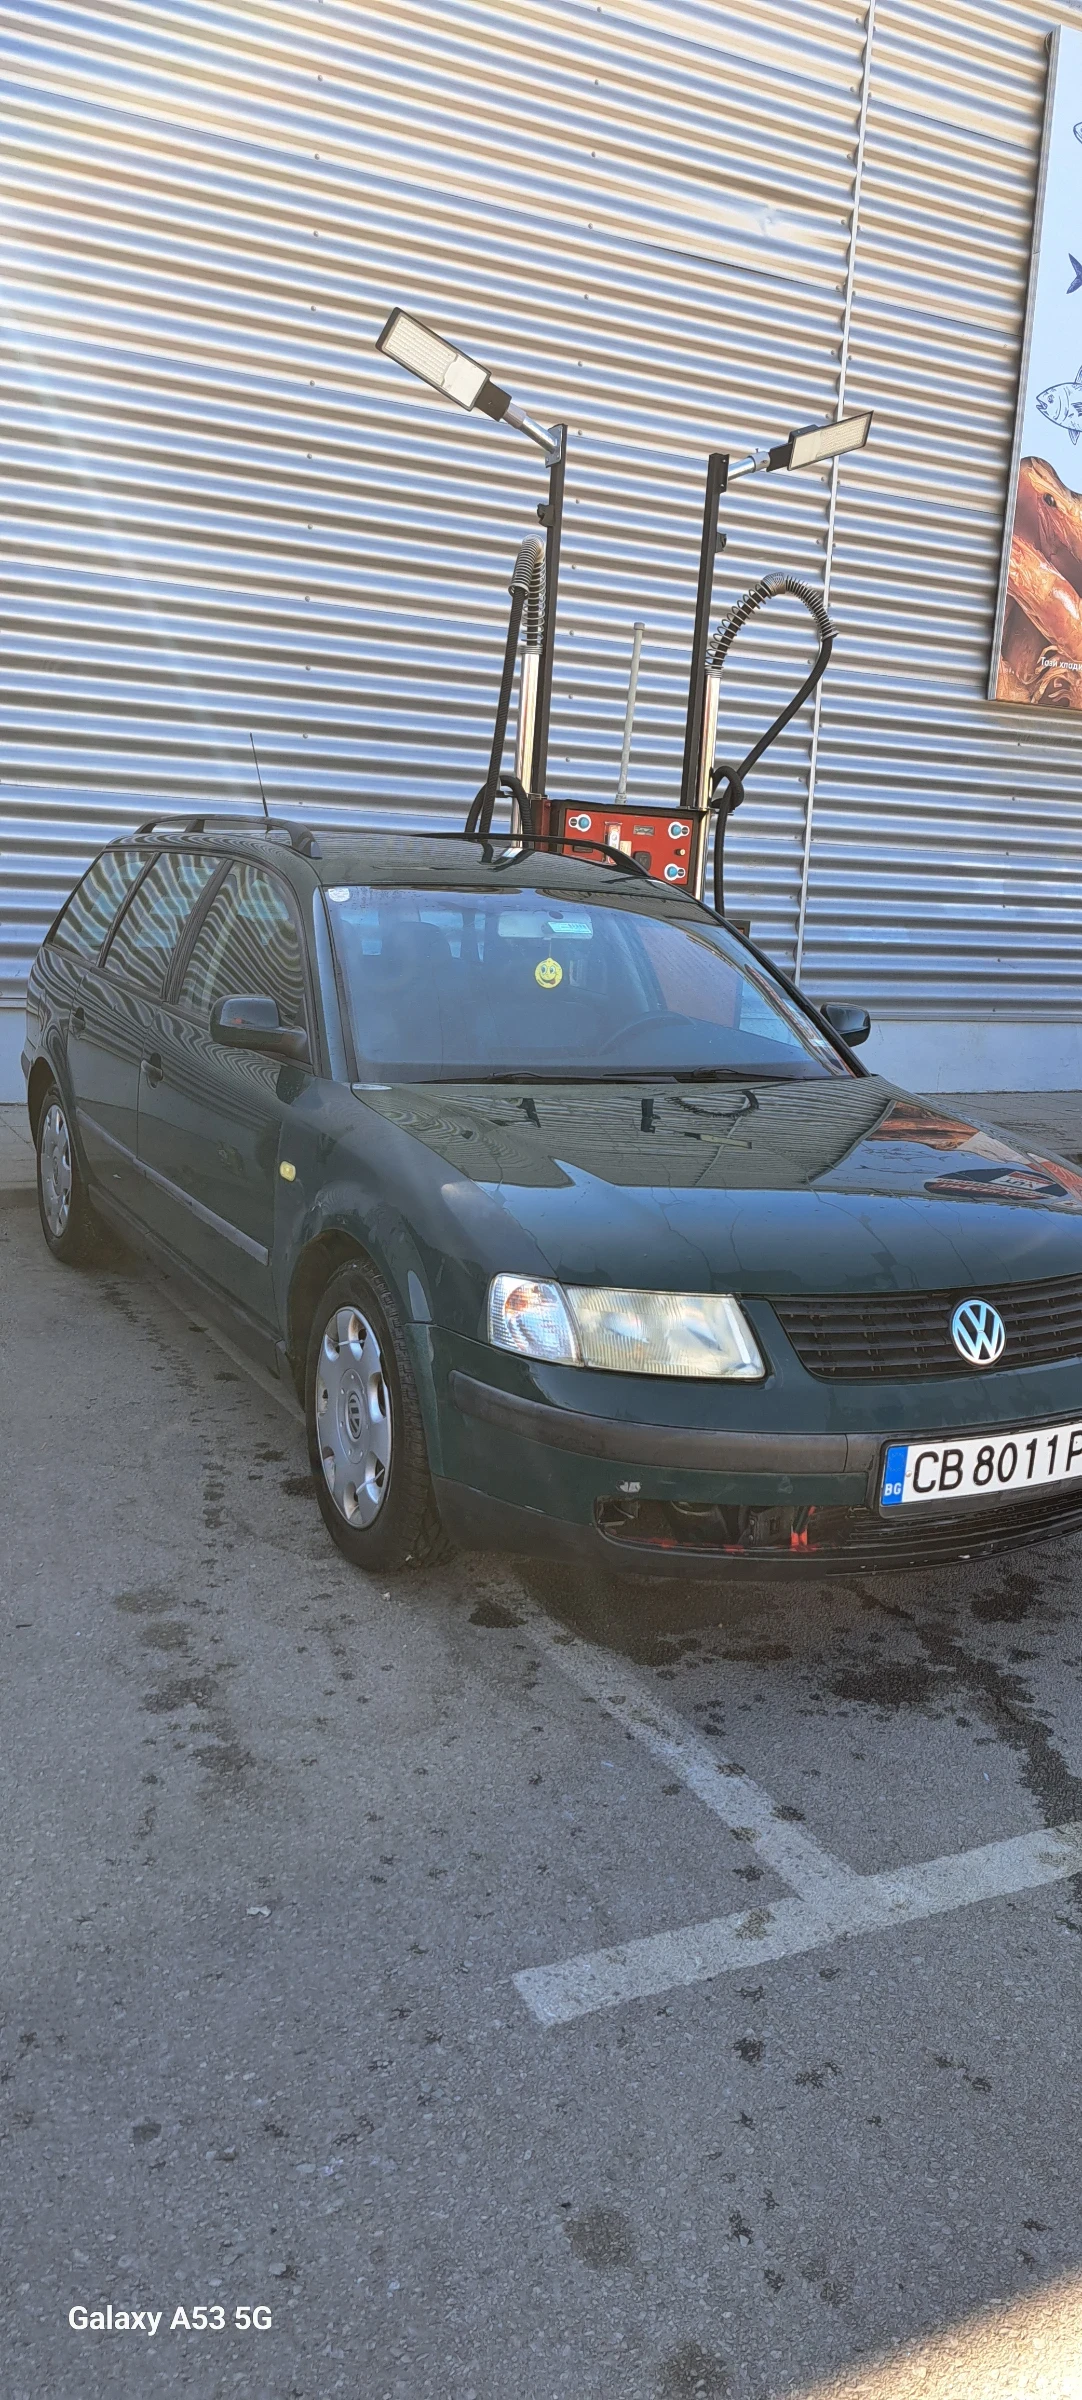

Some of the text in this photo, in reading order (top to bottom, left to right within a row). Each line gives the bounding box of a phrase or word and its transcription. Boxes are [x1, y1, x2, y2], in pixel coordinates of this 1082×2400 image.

[1041, 656, 1058, 667] Този
[952, 1299, 1005, 1365] VW
[912, 1448, 964, 1494] CB
[972, 1434, 1059, 1487] 8011
[884, 1482, 902, 1497] BG
